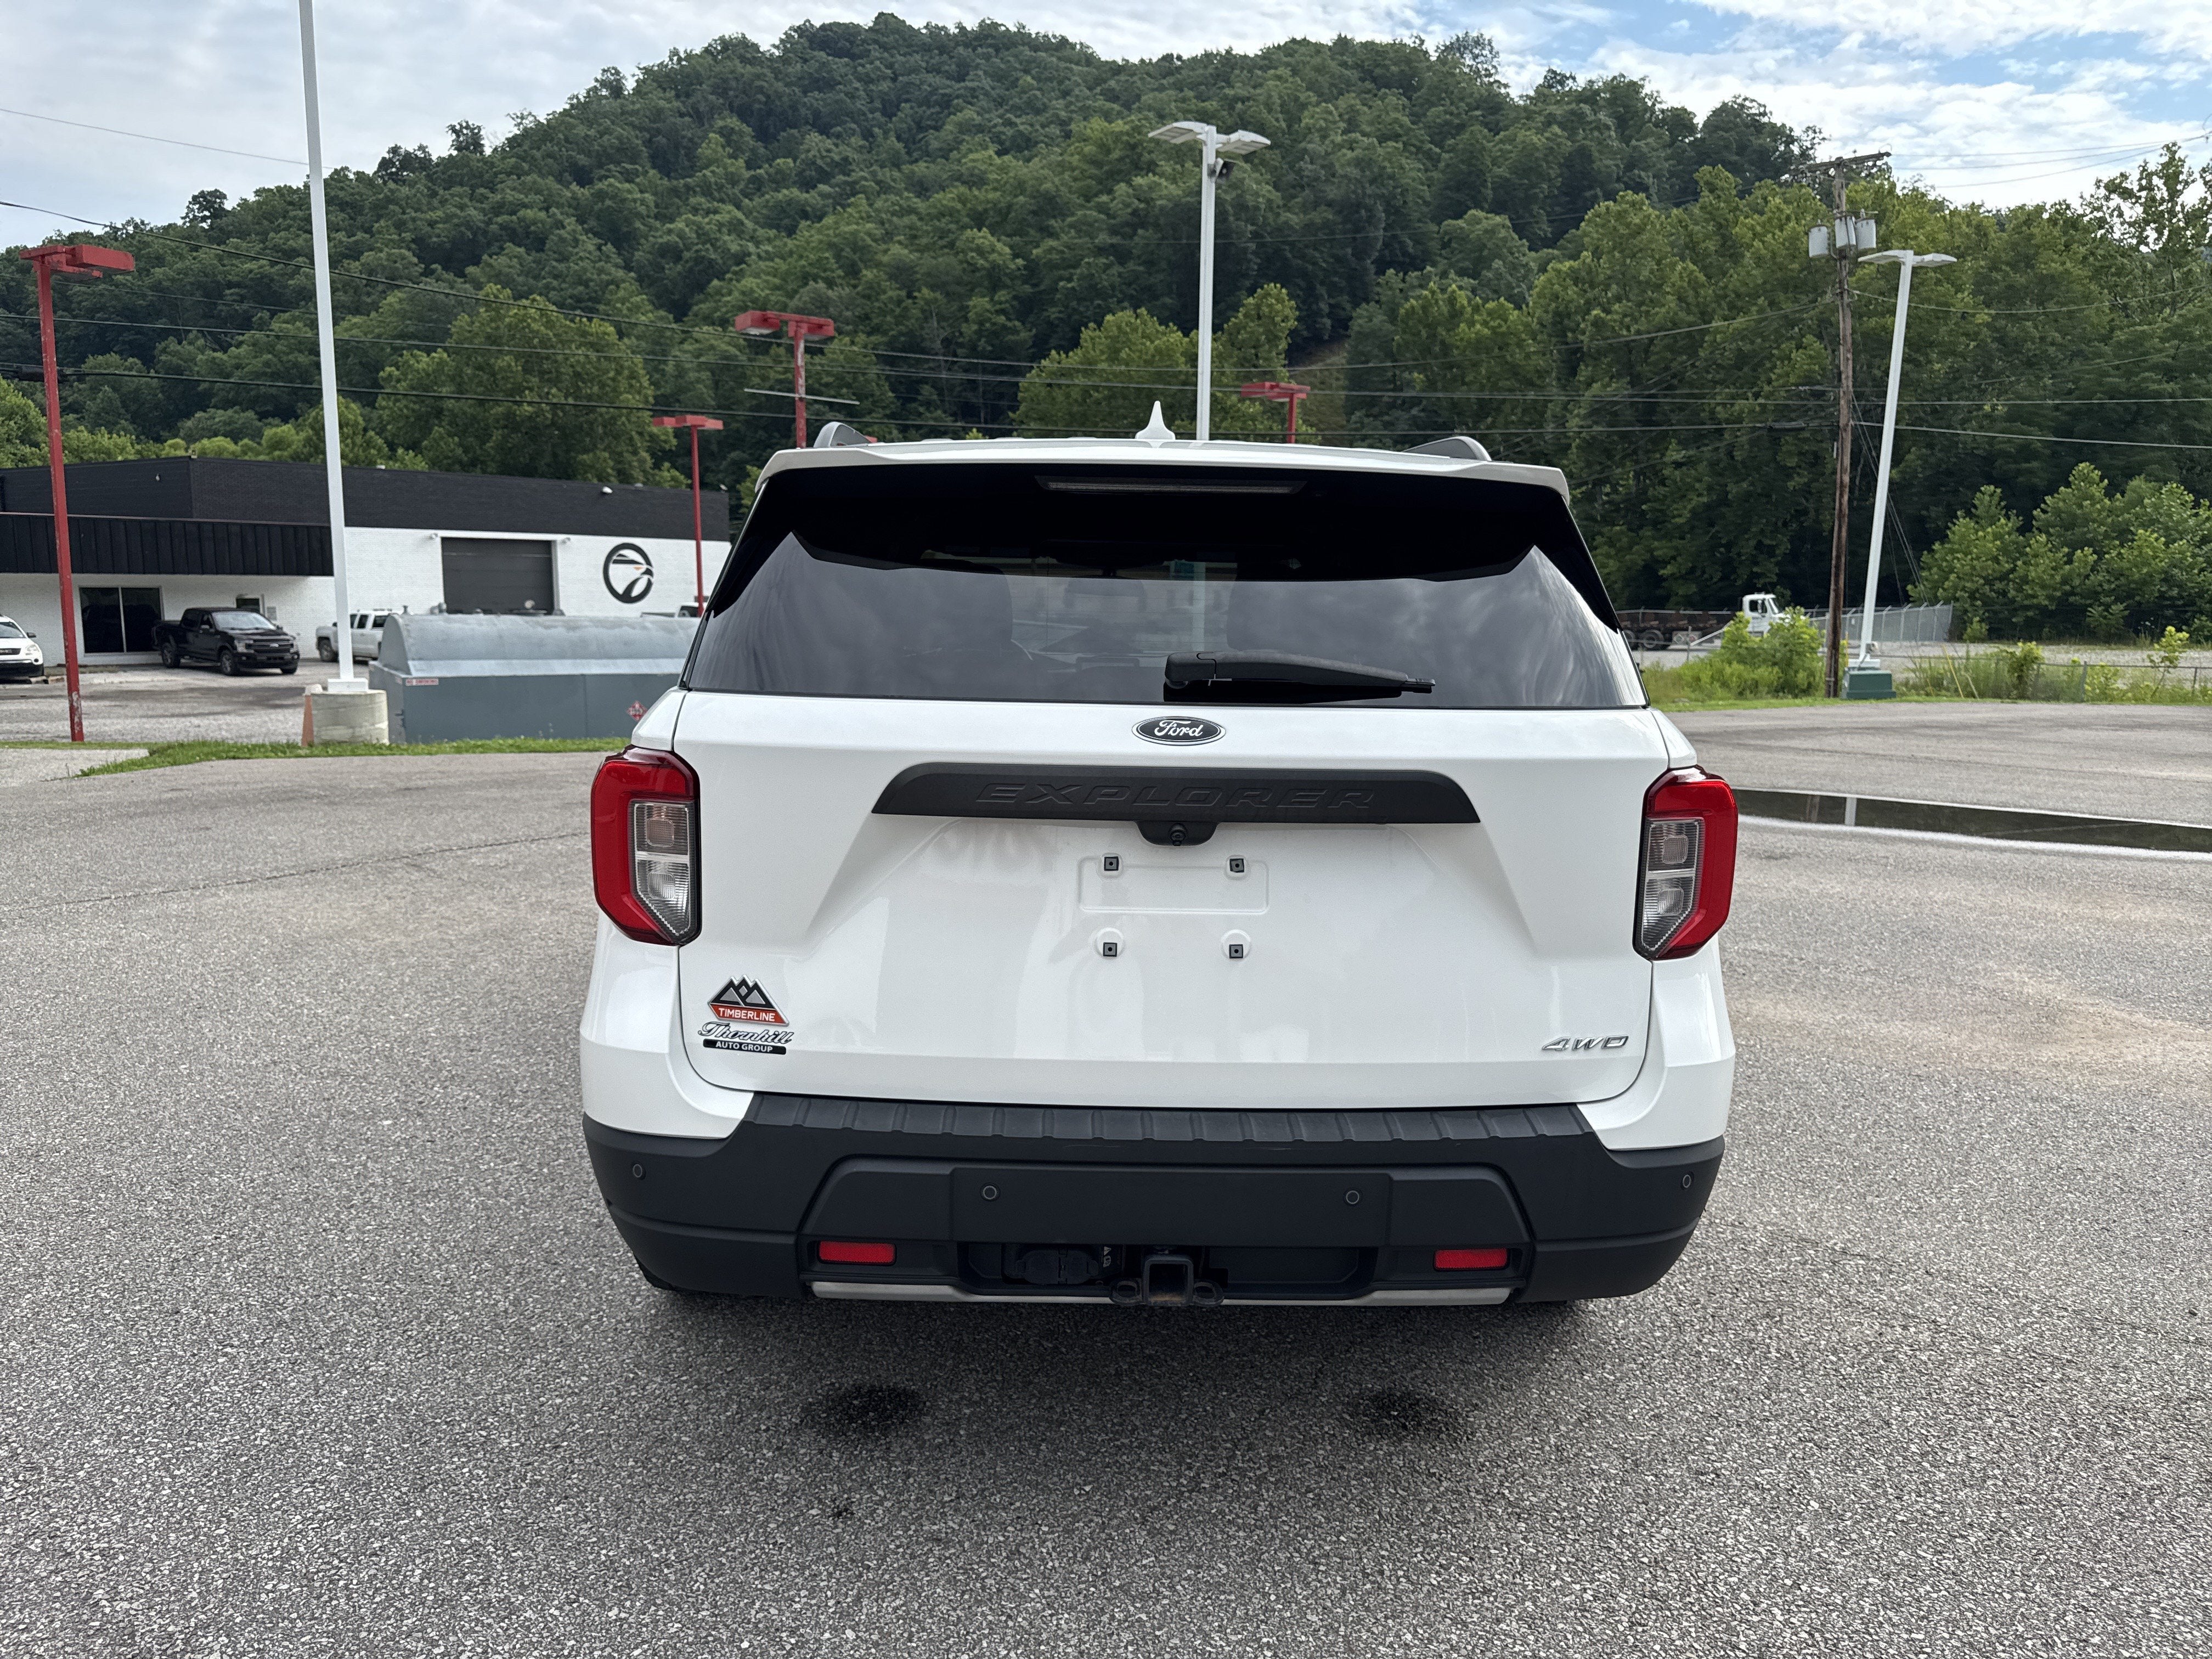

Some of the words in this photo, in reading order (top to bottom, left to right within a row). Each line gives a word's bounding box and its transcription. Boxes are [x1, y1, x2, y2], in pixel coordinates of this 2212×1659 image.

[1154, 720, 1203, 736] Ford
[975, 783, 1373, 808] EXPLORER
[718, 1007, 776, 1022] TIMBERLINE
[697, 1021, 794, 1044] Thornhill
[715, 1041, 740, 1049] AUTO
[741, 1043, 773, 1053] GROUP
[1541, 1034, 1629, 1051] 4WD
